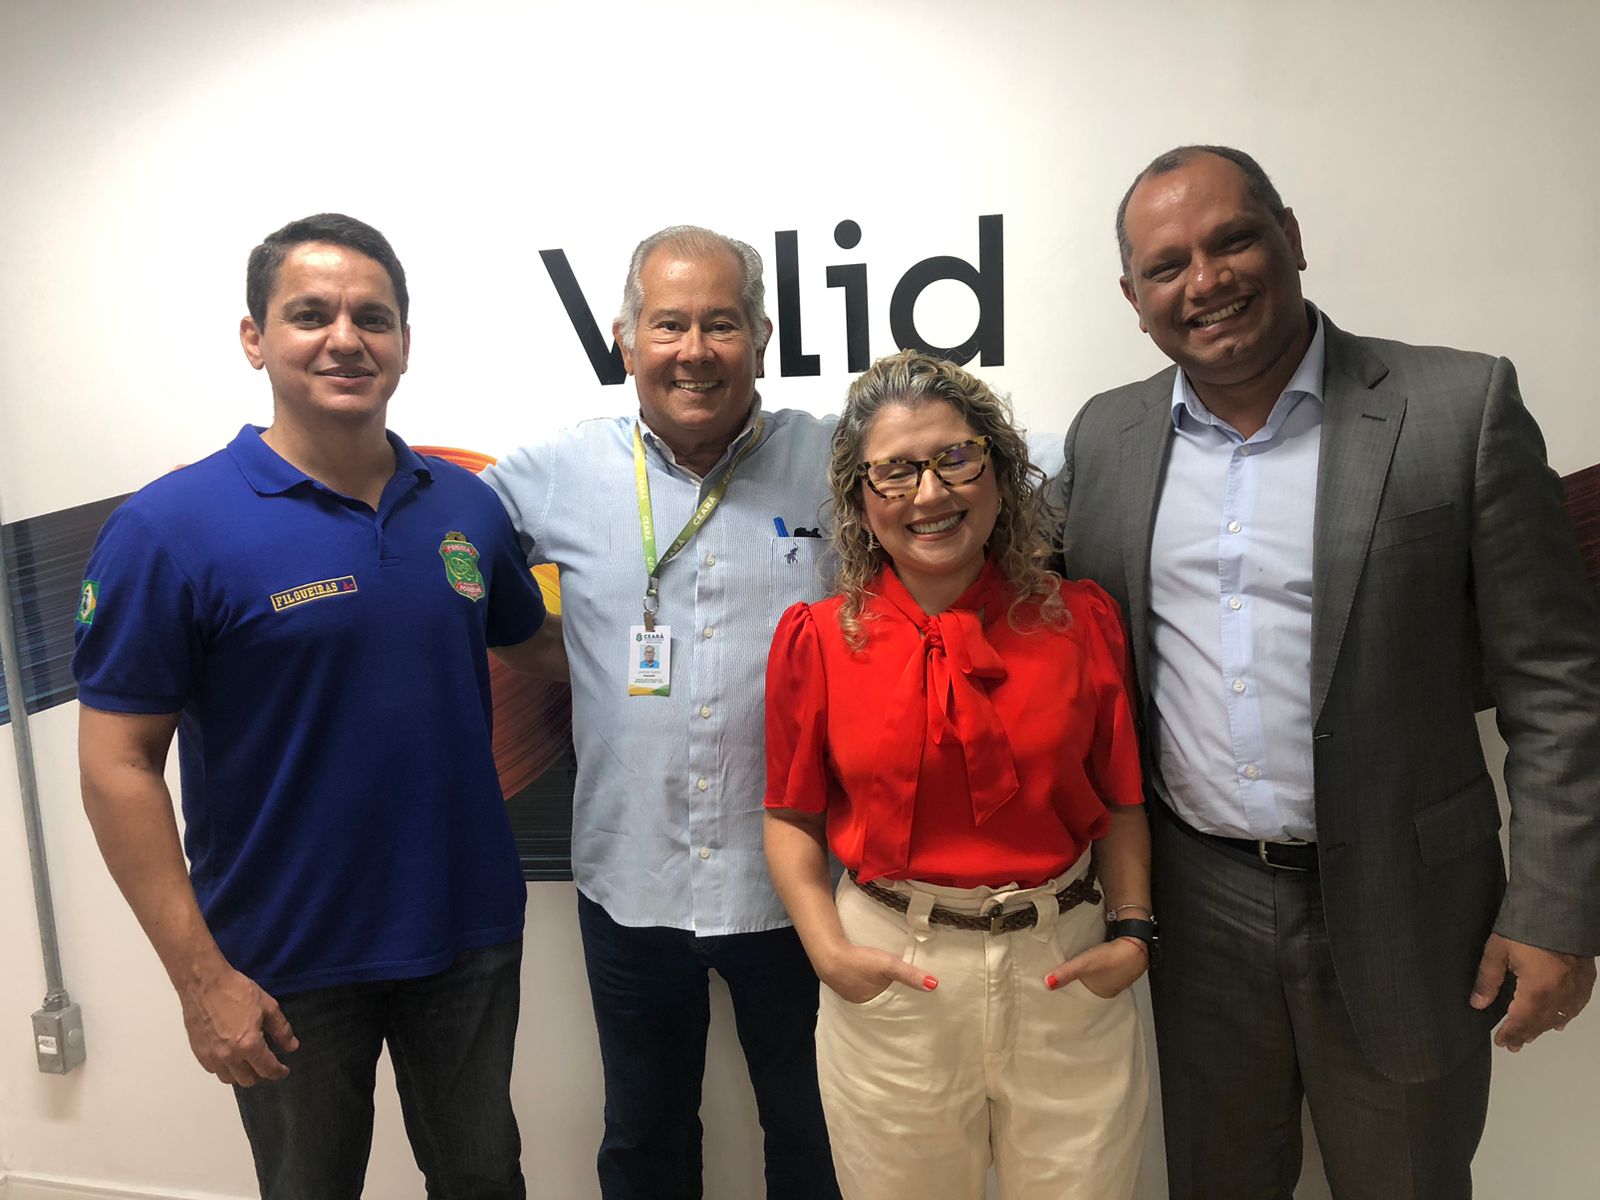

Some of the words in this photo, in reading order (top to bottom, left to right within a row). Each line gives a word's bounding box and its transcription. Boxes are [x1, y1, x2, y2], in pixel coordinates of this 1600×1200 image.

[538, 214, 1005, 386] Vlid
[693, 496, 717, 526] CEARÁ
[274, 582, 338, 607] FILGUEIRAS
